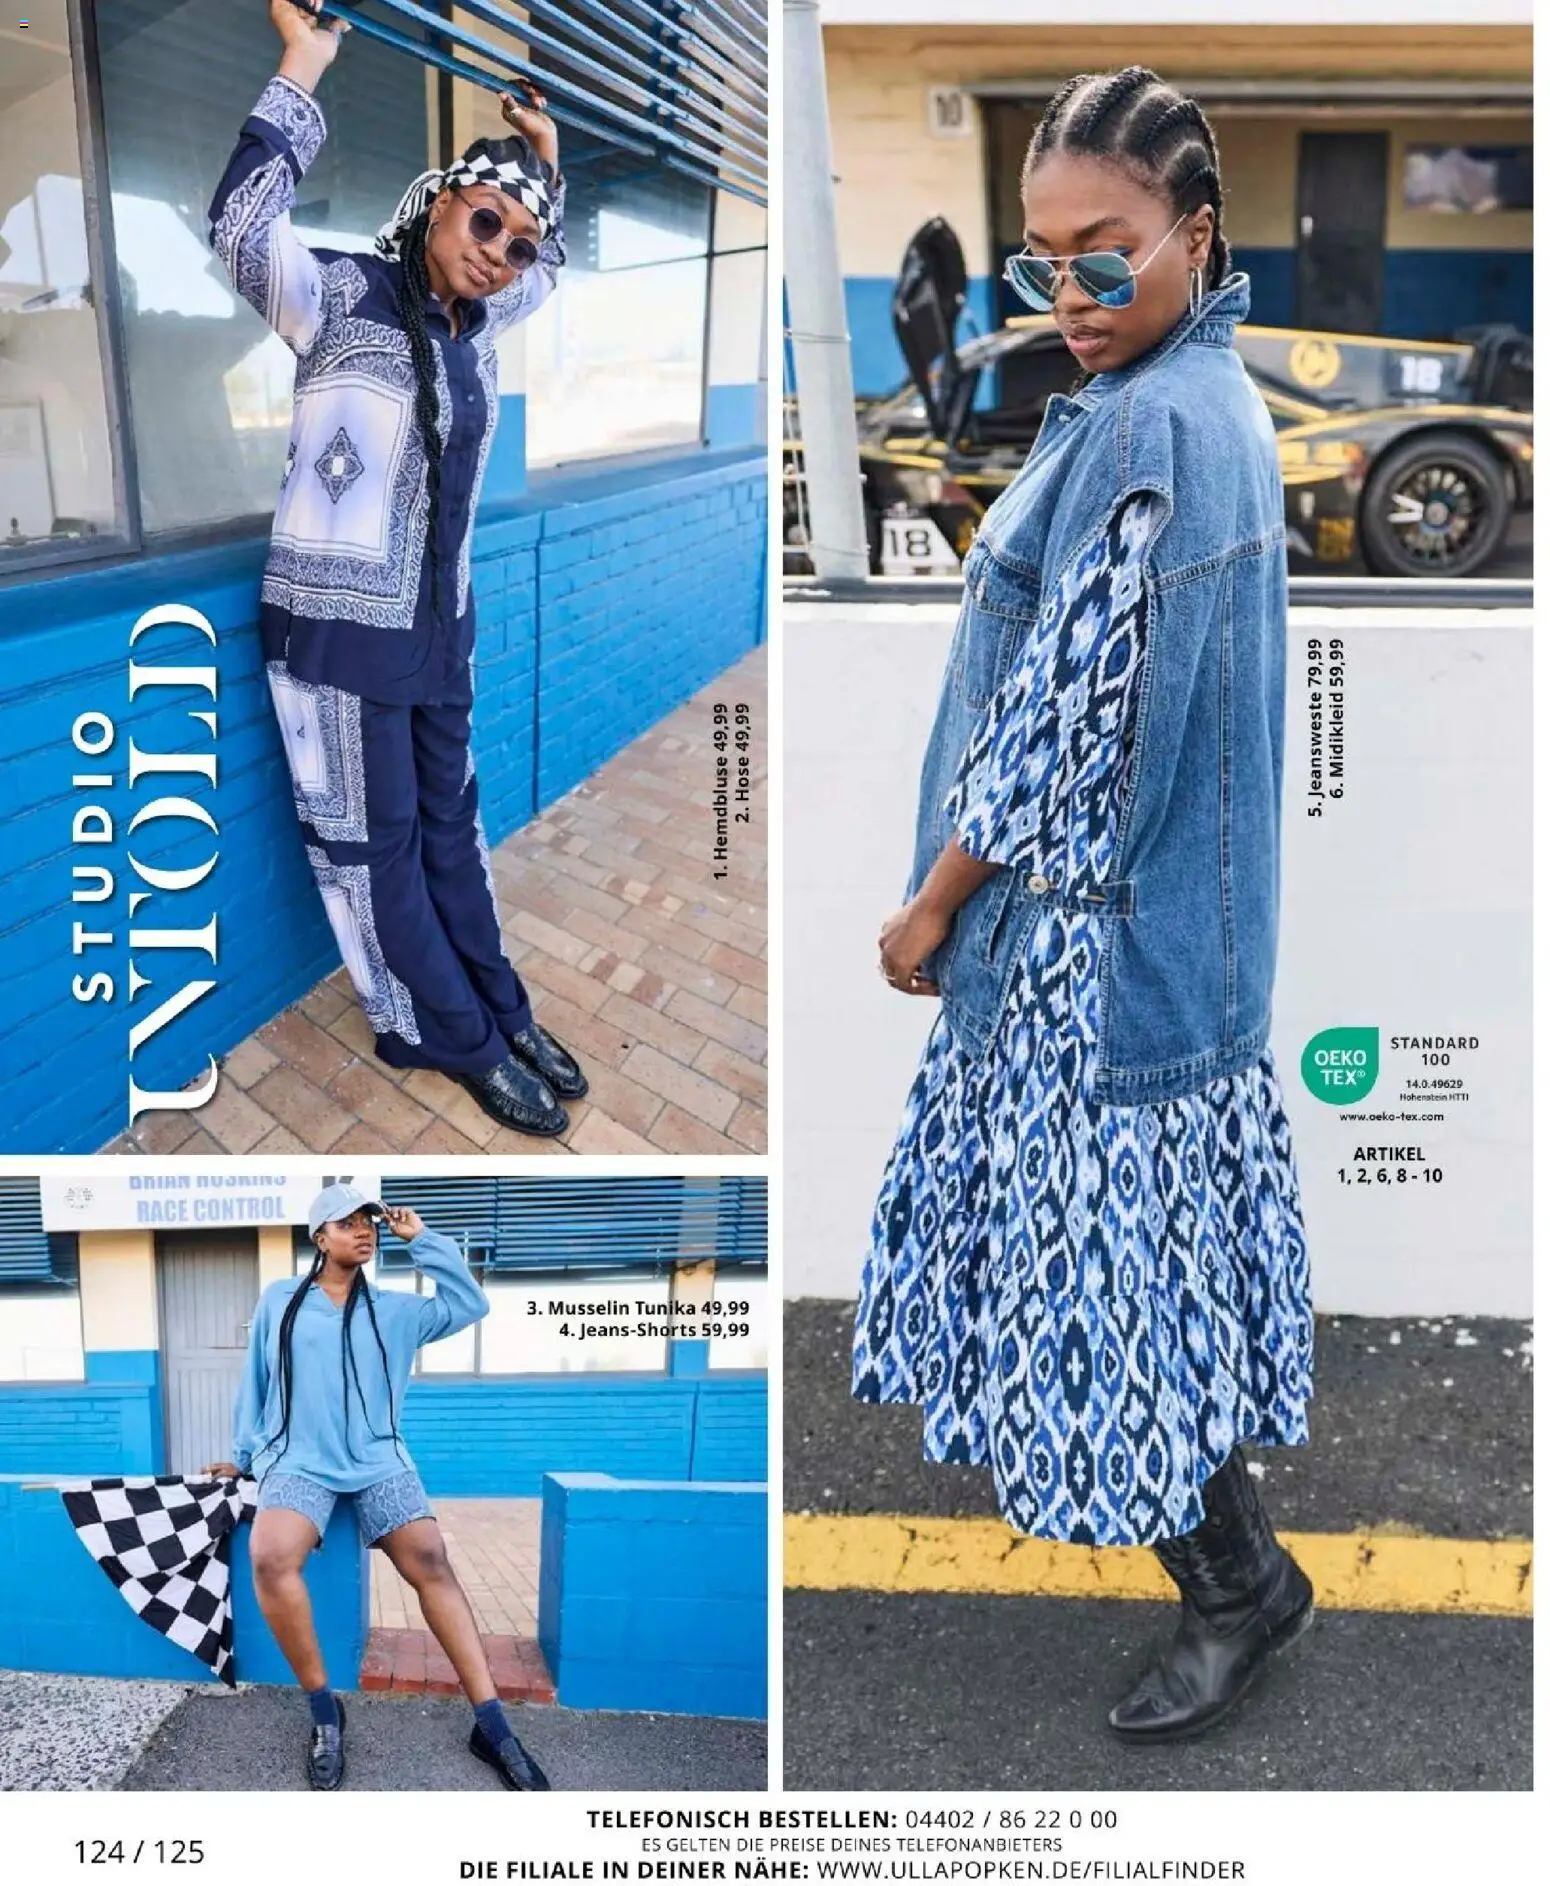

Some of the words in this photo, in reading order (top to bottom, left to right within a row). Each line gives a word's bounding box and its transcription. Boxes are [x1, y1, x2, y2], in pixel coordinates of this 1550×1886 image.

[1402, 355, 1442, 393] 18
[885, 528, 931, 557] 18
[137, 1200, 188, 1223] RACE
[193, 1196, 286, 1222] CONTROL
